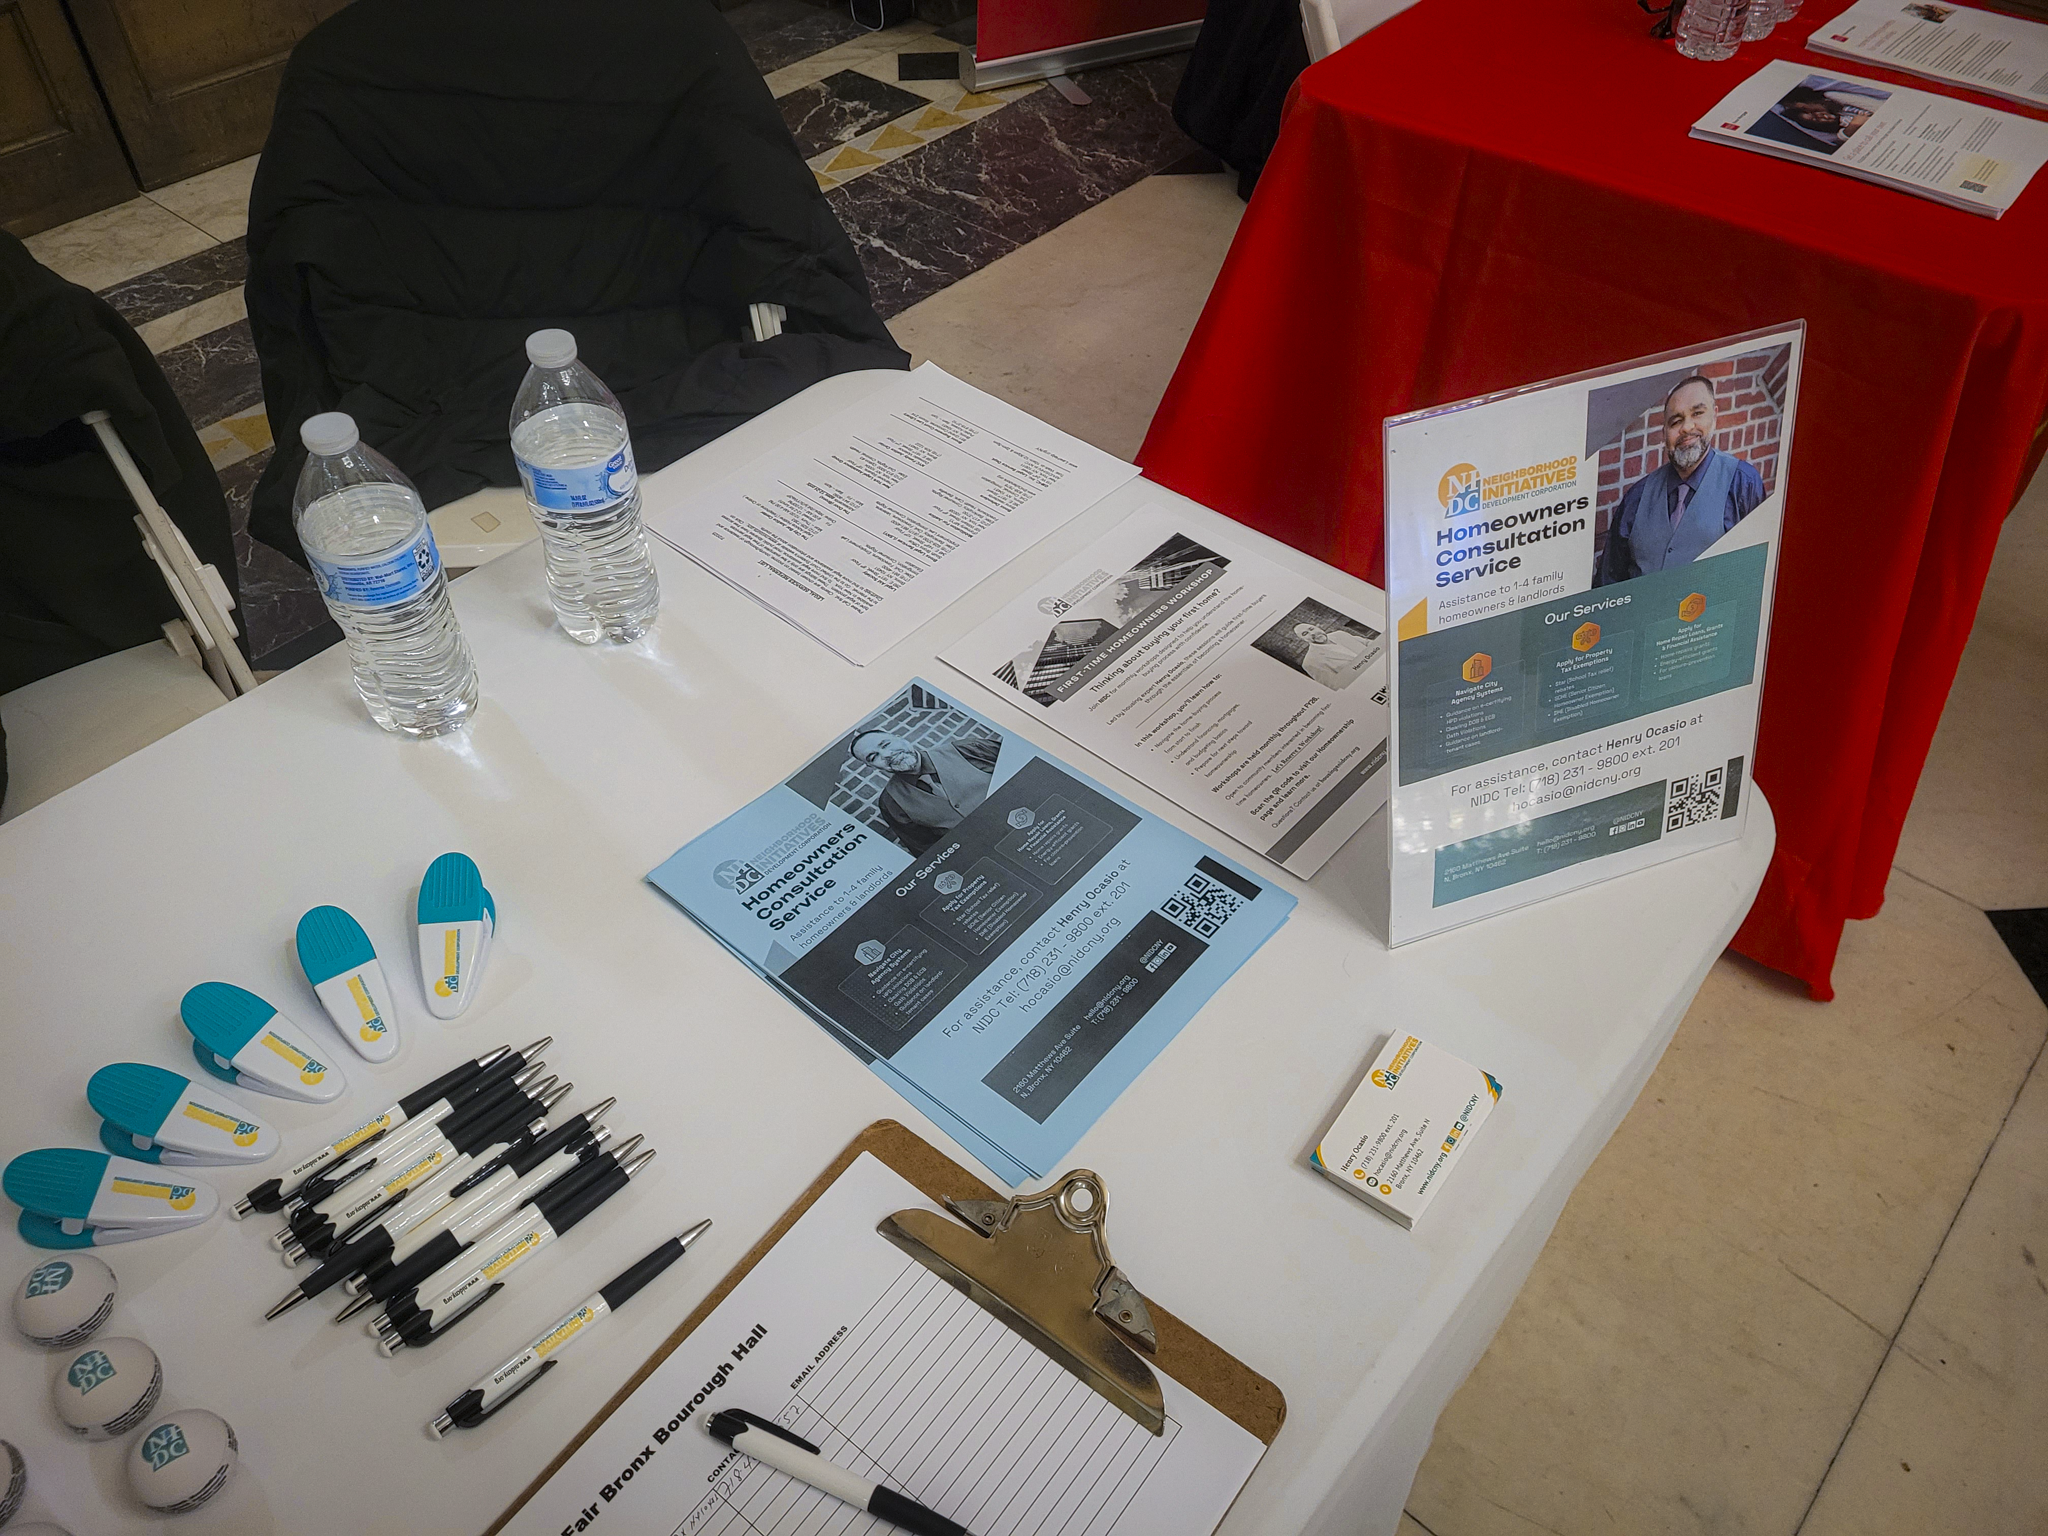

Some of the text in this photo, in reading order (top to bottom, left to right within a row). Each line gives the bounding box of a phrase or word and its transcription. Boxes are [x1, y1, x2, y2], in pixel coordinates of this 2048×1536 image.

[1482, 455, 1577, 486] NEIGHBORHOOD
[1482, 465, 1576, 500] INITIATIVES
[1446, 490, 1479, 517] DC
[1481, 479, 1577, 510] DEVELOPMENT CORPORATION
[1436, 496, 1589, 545] Homeowners
[1436, 518, 1585, 566] Consultation
[1064, 570, 1109, 603] INITIATIVES
[1435, 555, 1521, 587] Service
[1438, 570, 1564, 610] Assistance to 1-4 family
[1048, 601, 1072, 616] DC
[1438, 583, 1565, 624] homeowners & landlords
[1543, 594, 1631, 625] Our Services
[1056, 568, 1212, 693] FIRST-TIME HOMEOWNERS WORKSHOP
[1088, 587, 1221, 692] Thinking about buying your first home?
[1351, 646, 1381, 671] Henry Ocasio
[1555, 647, 1613, 668] Apply for Property
[1560, 655, 1609, 674] Tax Exemptions
[1450, 684, 1503, 705] Agency Systems
[1455, 679, 1498, 696] Navigate City
[1210, 767, 1241, 793] Workshops
[1238, 759, 1250, 769] are
[1245, 748, 1261, 761] held
[1258, 731, 1282, 751] monthly
[1277, 706, 1307, 733] throughout
[1450, 712, 1703, 796] For assistance, contact Henry Ocasio at
[1469, 789, 1500, 807] NIDC
[1503, 781, 1525, 797] Tel:
[1562, 764, 1584, 781] 231
[1596, 750, 1629, 770] 9800
[1631, 744, 1656, 759] ext.
[1658, 735, 1680, 752] 201
[1511, 766, 1641, 814] hocasio@nidcny.org
[749, 812, 817, 865] NEIGHBORHOOD
[755, 816, 826, 871] INITIATIVES
[763, 821, 832, 876] DEVELOPMENT CORPORATION
[730, 868, 764, 894] DC
[741, 823, 855, 910] Homeowners
[756, 833, 867, 919] Consultation
[894, 842, 960, 897] Our Services
[768, 878, 836, 931] Service
[789, 864, 884, 941] Assistance to 1-4 family
[798, 869, 893, 949] homeowners & landlords
[941, 858, 1131, 1038] For assistance, contact Henry Ocasio at
[971, 1007, 1000, 1034] NIDC
[995, 989, 1020, 1008] Tel:
[1015, 964, 1047, 992] (718)
[1040, 946, 1063, 967] 231
[1064, 916, 1094, 943] 9800
[1092, 900, 1114, 918] ext.
[1109, 880, 1131, 900] 201
[1018, 917, 1121, 1012] hocasio@nidcny.org
[1138, 938, 1163, 964] @NIDCNY
[1082, 974, 1131, 1020] hello@nidcny.org
[1011, 1022, 1083, 1094] 2160 Matthews Ave Suite
[1388, 1035, 1413, 1071] NEIGHBORHOOD
[1392, 1037, 1419, 1074] INITIATIVES
[1019, 1090, 1031, 1099] N,
[1025, 1072, 1048, 1093] Bronx,
[1043, 1062, 1055, 1074] NY
[1384, 1072, 1400, 1089] DC
[1458, 1093, 1479, 1122] @NIDCNY
[1339, 1134, 1369, 1172] Henry Ocasio
[1359, 1112, 1400, 1170] (718) 231-9800 ext. 201
[1372, 1128, 1408, 1176] hocasio@nidcny.org
[1385, 1117, 1430, 1184] 2160 Matthews Ave, Suite N
[292, 1151, 331, 1178] www.nidcny.org
[1394, 1147, 1424, 1190] Bronx, NY 10462
[1417, 1151, 1448, 1195] www.nidcny.org
[344, 1192, 384, 1220] www.nidcny.org
[27, 1267, 45, 1295] DC
[442, 1276, 482, 1307] www.nidcny.org
[493, 1354, 534, 1387] www.nidcny.org
[789, 1325, 848, 1390] EMAIL ADDRESS
[82, 1365, 115, 1393] DC
[561, 1502, 600, 1536] Fair
[598, 1445, 655, 1502] Bronx
[652, 1362, 733, 1444] Bourough
[730, 1323, 767, 1361] Hall
[154, 1441, 187, 1468] DC
